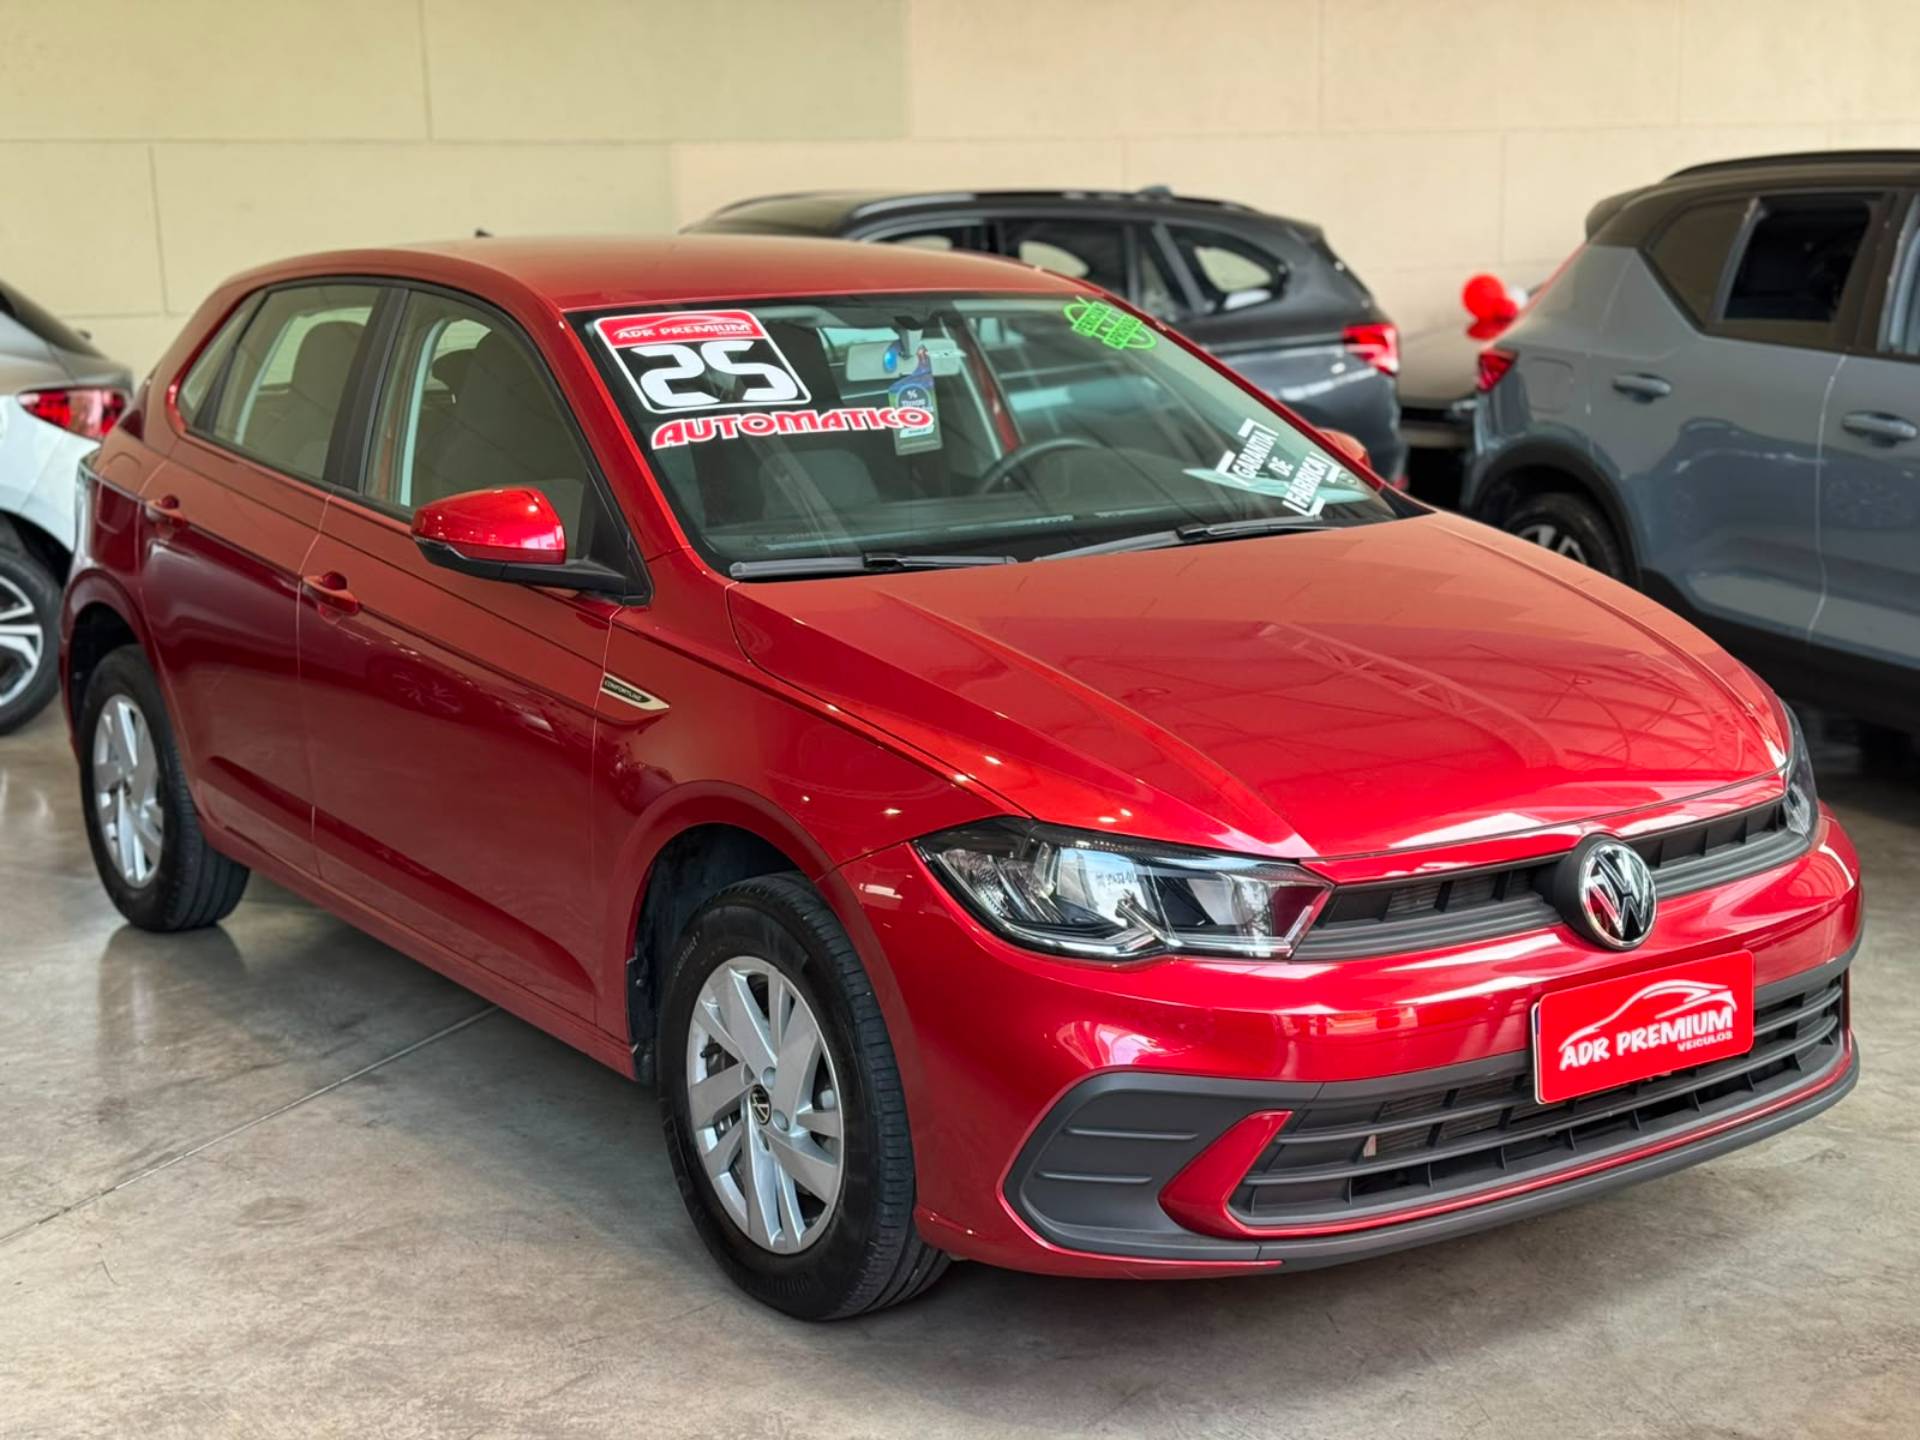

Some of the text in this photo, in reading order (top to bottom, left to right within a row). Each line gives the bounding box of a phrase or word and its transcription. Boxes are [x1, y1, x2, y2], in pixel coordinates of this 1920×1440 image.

[617, 329, 656, 340] ADR
[659, 322, 753, 337] PREMIUM
[630, 340, 799, 407] 25
[651, 407, 934, 450] AUTOMATICO
[1231, 430, 1278, 480] GARANTIA
[1267, 456, 1294, 477] DE
[1284, 456, 1329, 509] FABRICA
[1559, 1006, 1734, 1071] ADR PREMIUM
[1677, 1030, 1734, 1053] VEICULOS
